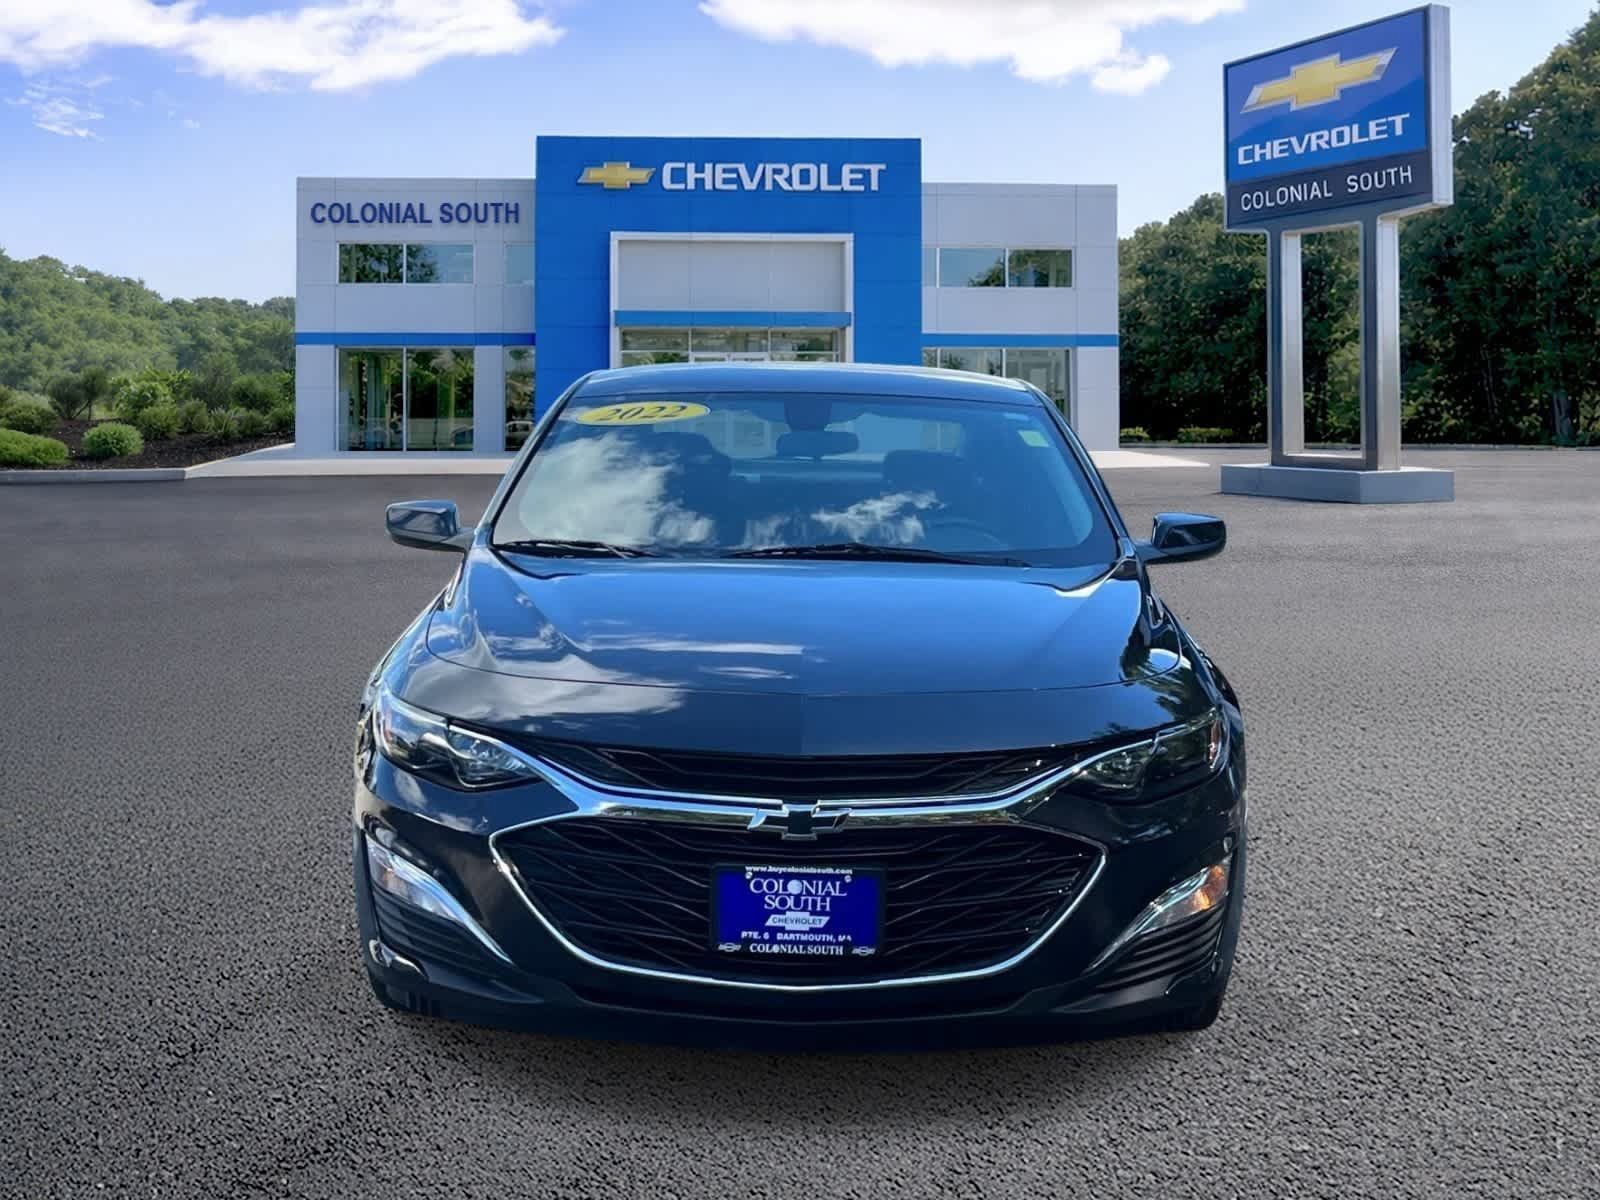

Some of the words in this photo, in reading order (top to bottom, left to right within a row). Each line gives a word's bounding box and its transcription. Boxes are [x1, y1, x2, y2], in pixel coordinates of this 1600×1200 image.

[1237, 113, 1410, 165] CHEVROLET
[661, 161, 887, 192] CHEVROLET
[1241, 180, 1333, 212] COLONIAL
[1346, 165, 1413, 194] SOUTH
[309, 202, 433, 225] COLONIAL
[439, 202, 520, 225] SOUTH
[593, 405, 688, 421] 2022
[750, 877, 847, 896] COLONIAL
[764, 895, 831, 912] SOUTH
[771, 915, 824, 926] CHEVROLET
[776, 932, 836, 943] DARTMOUTH,
[750, 943, 806, 954] COLONIAL
[807, 945, 844, 956] SOUTH
